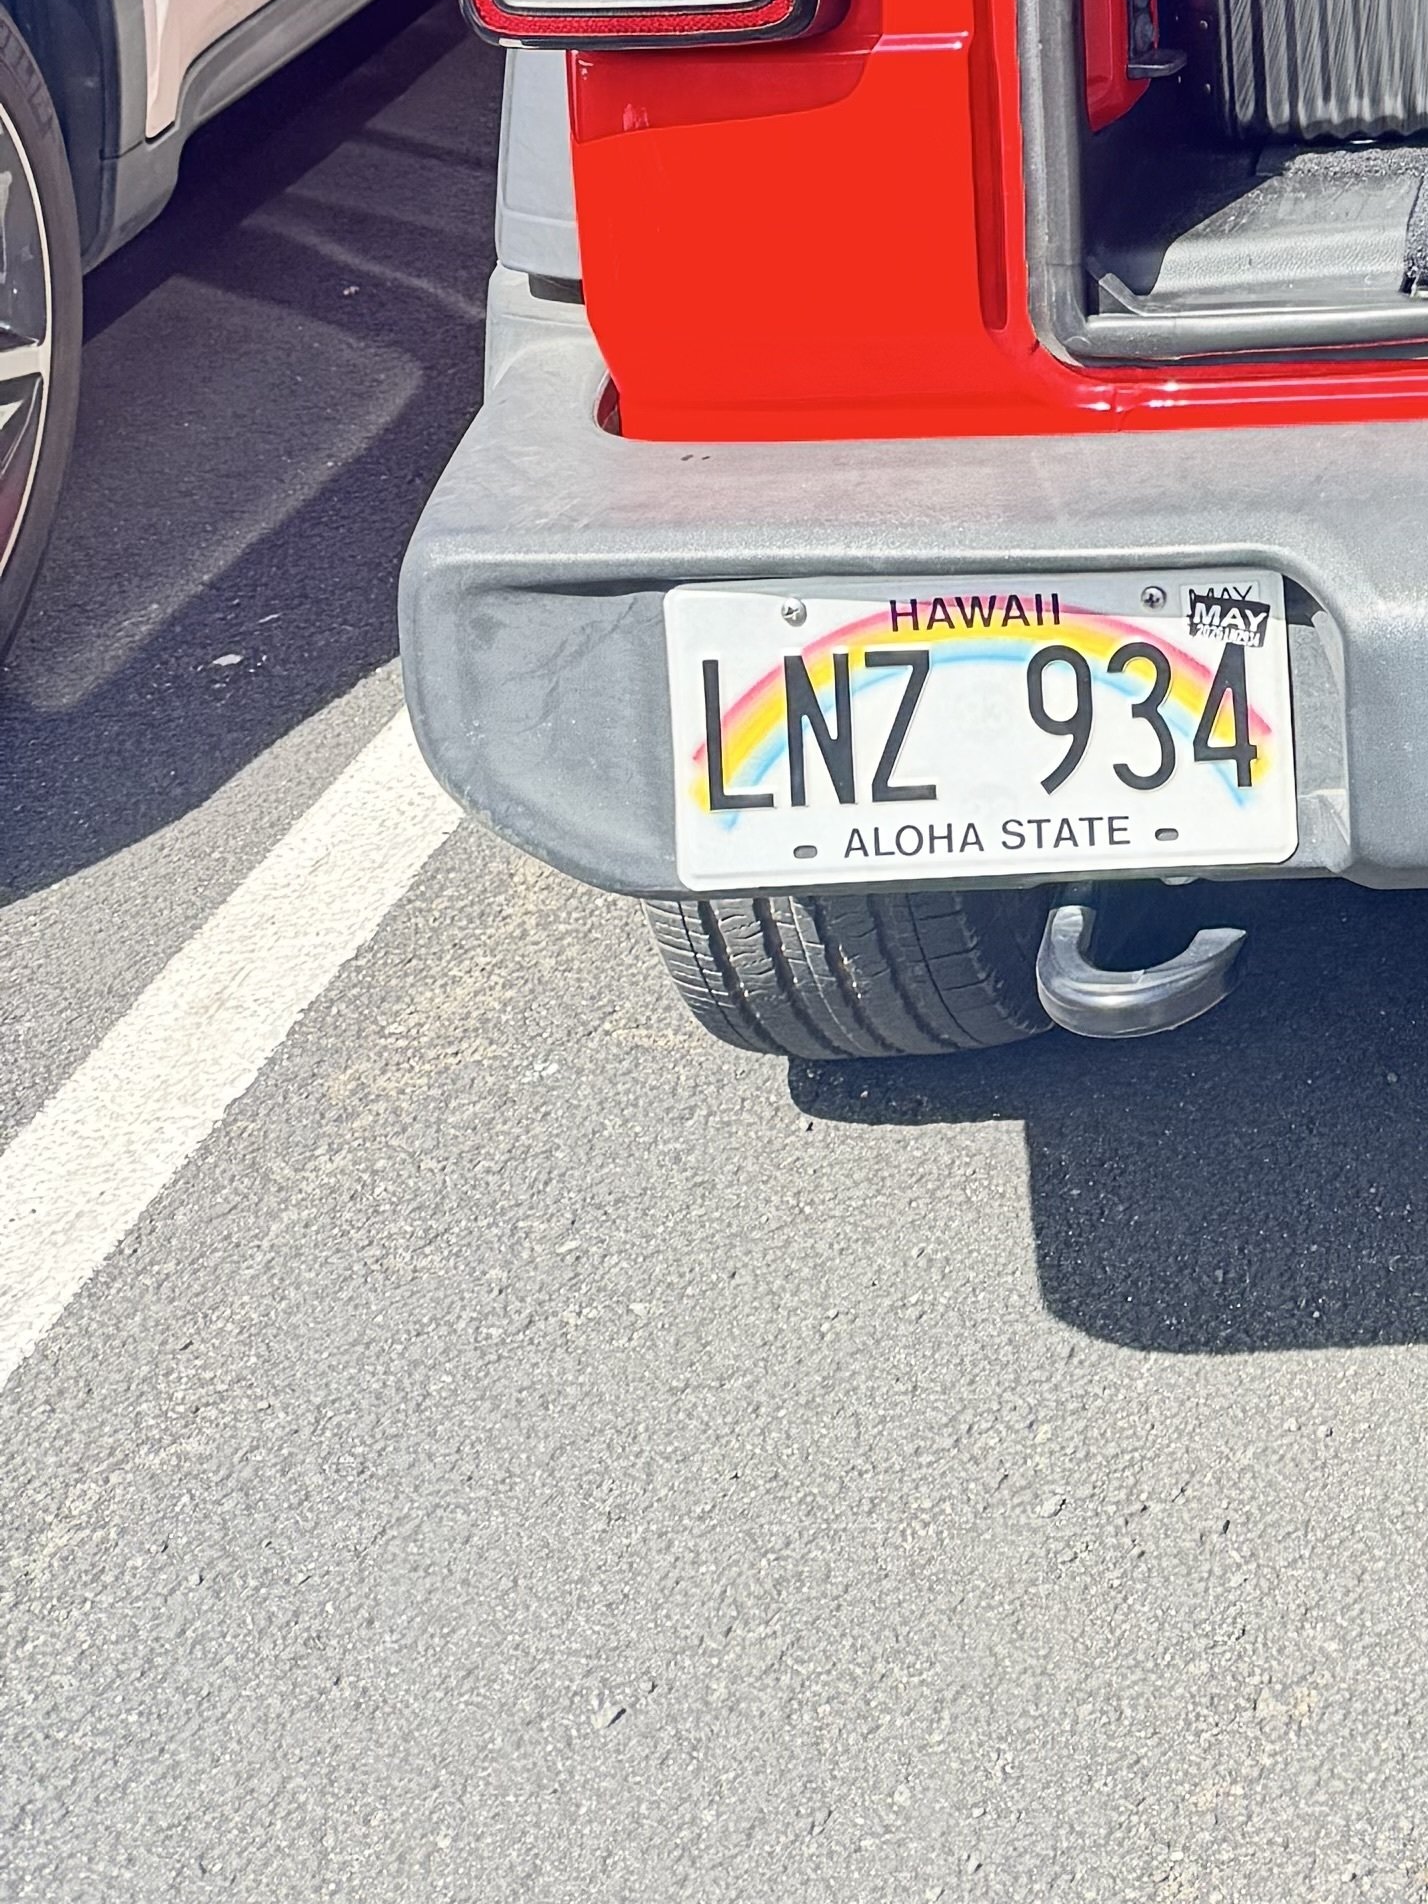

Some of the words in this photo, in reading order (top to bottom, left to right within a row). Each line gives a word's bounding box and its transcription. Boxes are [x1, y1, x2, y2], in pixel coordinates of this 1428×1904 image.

[888, 593, 1062, 632] HAWAII
[1193, 602, 1268, 631] MAY
[701, 647, 938, 812] LNZ
[1026, 640, 1262, 796] 934
[843, 820, 983, 859] ALOHA
[1000, 814, 1132, 852] STATE
